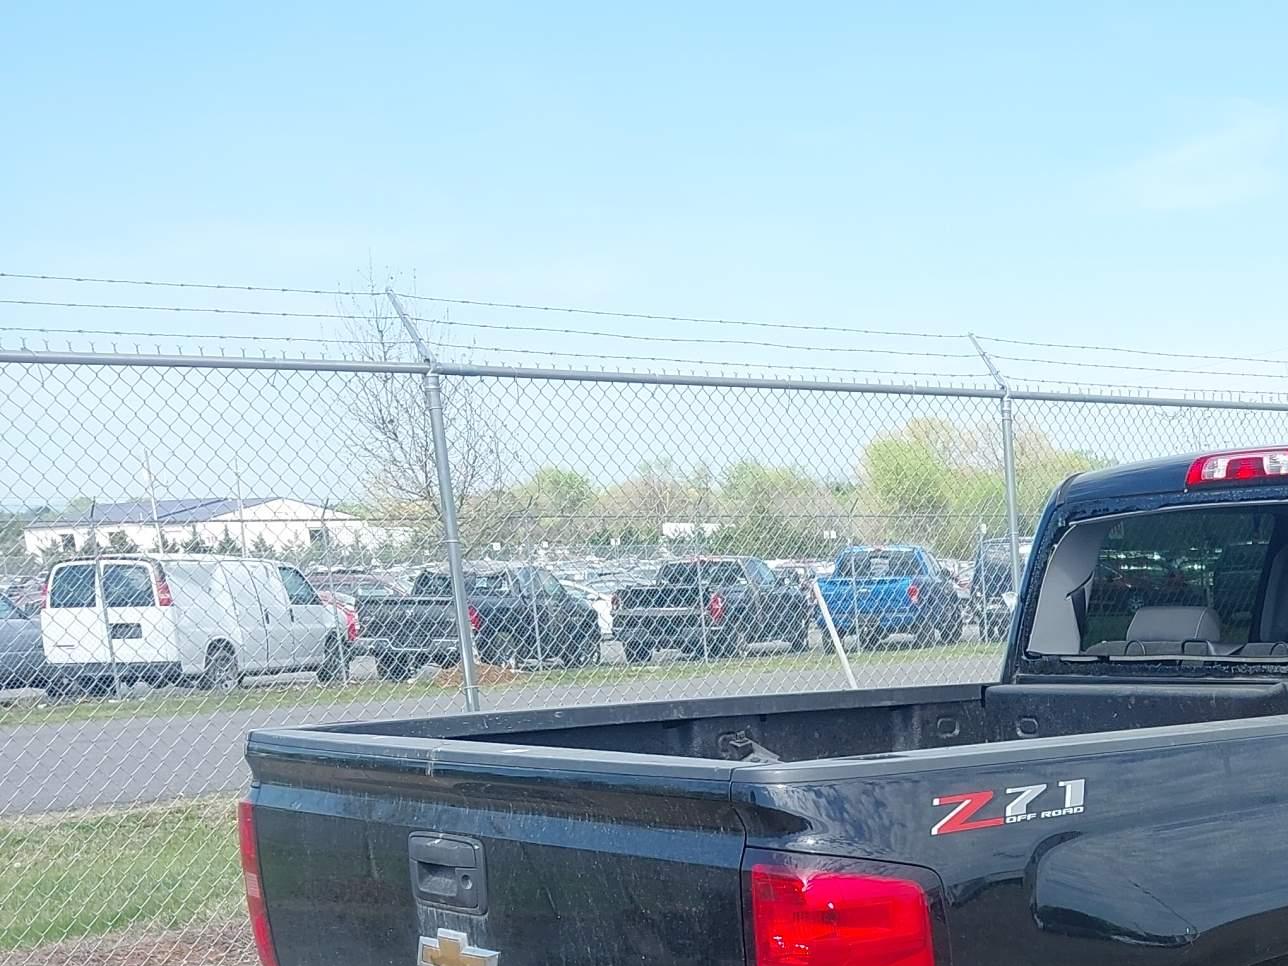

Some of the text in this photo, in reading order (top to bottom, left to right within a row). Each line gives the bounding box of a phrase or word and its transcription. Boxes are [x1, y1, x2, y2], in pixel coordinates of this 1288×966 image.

[931, 778, 1085, 836] Z71
[1005, 806, 1085, 824] OFF ROAD
